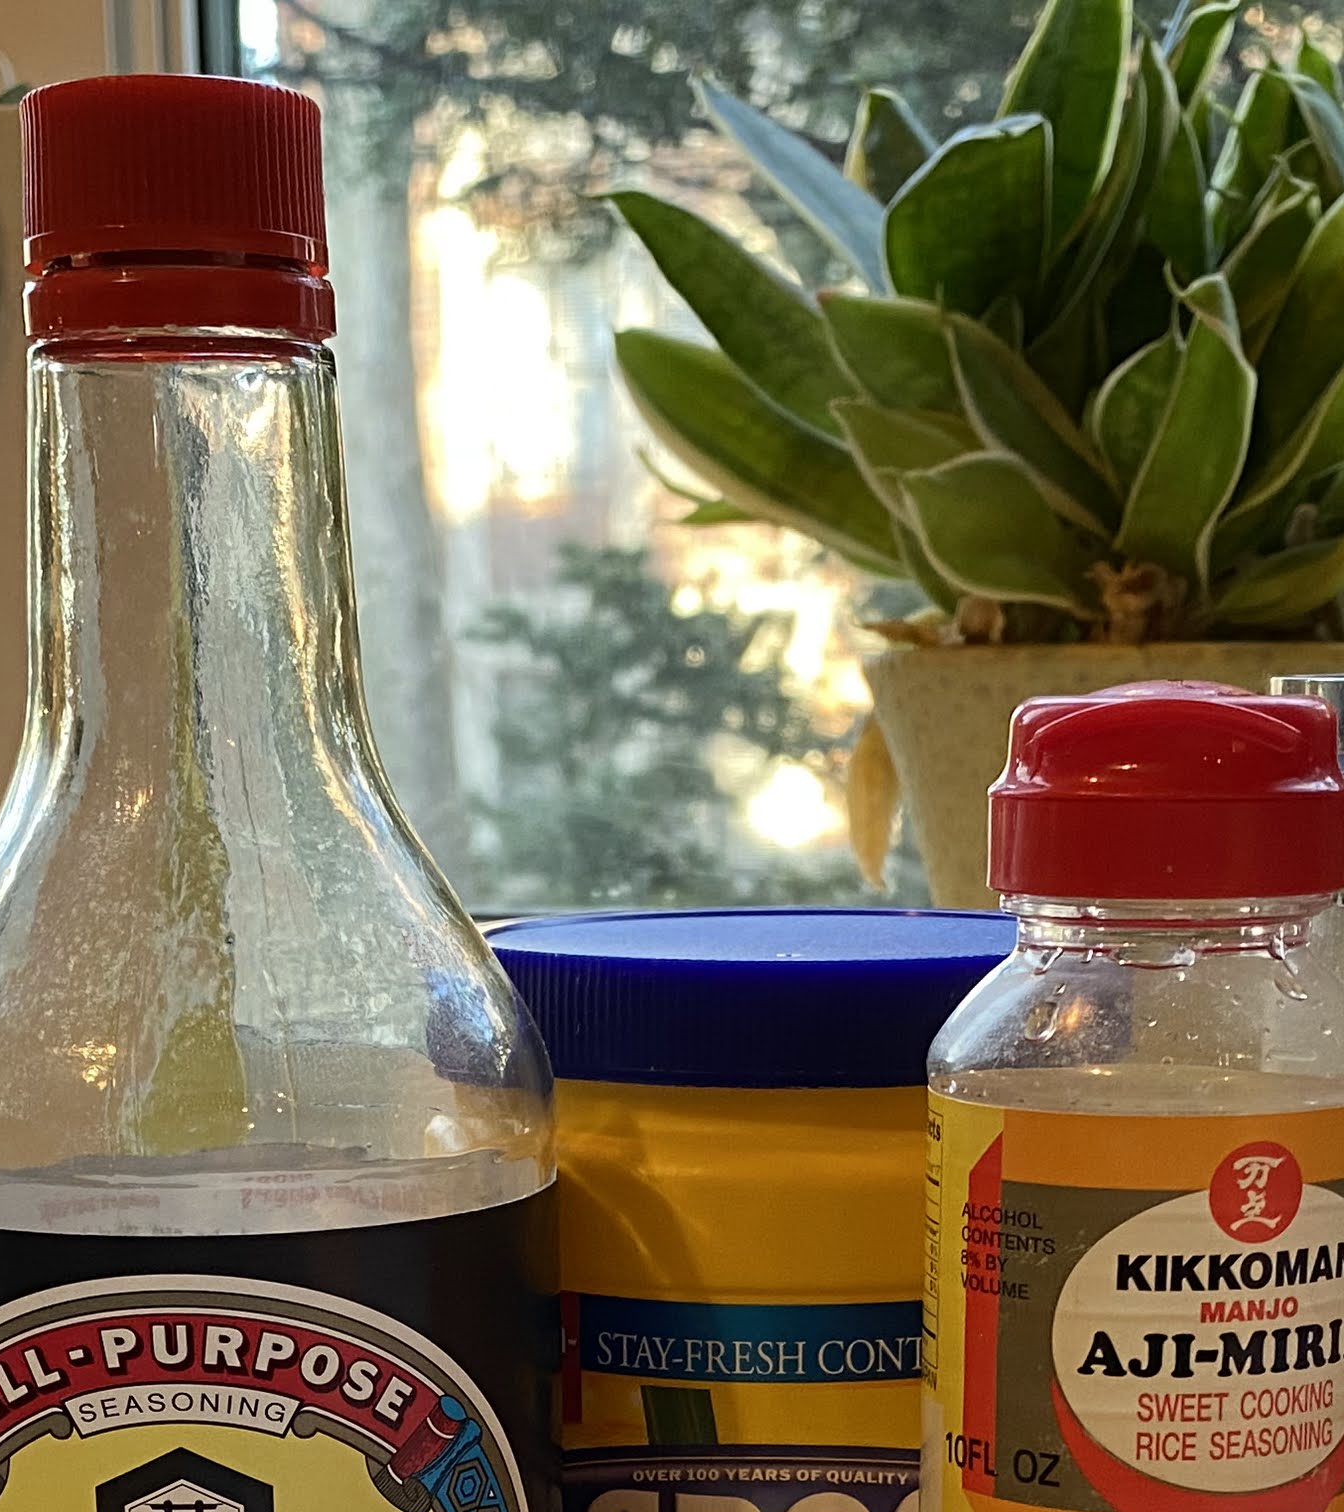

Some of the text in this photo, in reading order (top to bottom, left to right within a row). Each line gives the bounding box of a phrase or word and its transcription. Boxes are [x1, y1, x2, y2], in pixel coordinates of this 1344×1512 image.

[961, 1202, 1044, 1230] ALCOHOL
[961, 1225, 1056, 1255] CONTENTS
[960, 1249, 1008, 1273] 8% BY
[960, 1271, 1030, 1300] VOLUME
[1200, 1296, 1298, 1324] MANJO
[596, 1331, 806, 1375] STAY-FRESH
[78, 1391, 288, 1425] SEASONING
[1136, 1379, 1334, 1423] SWEET COOKING
[1135, 1417, 1333, 1461] RICE SEASONING
[632, 1468, 909, 1486] OVER 100 YEARS OF QUALITY
[1013, 1449, 1060, 1488] OZ
